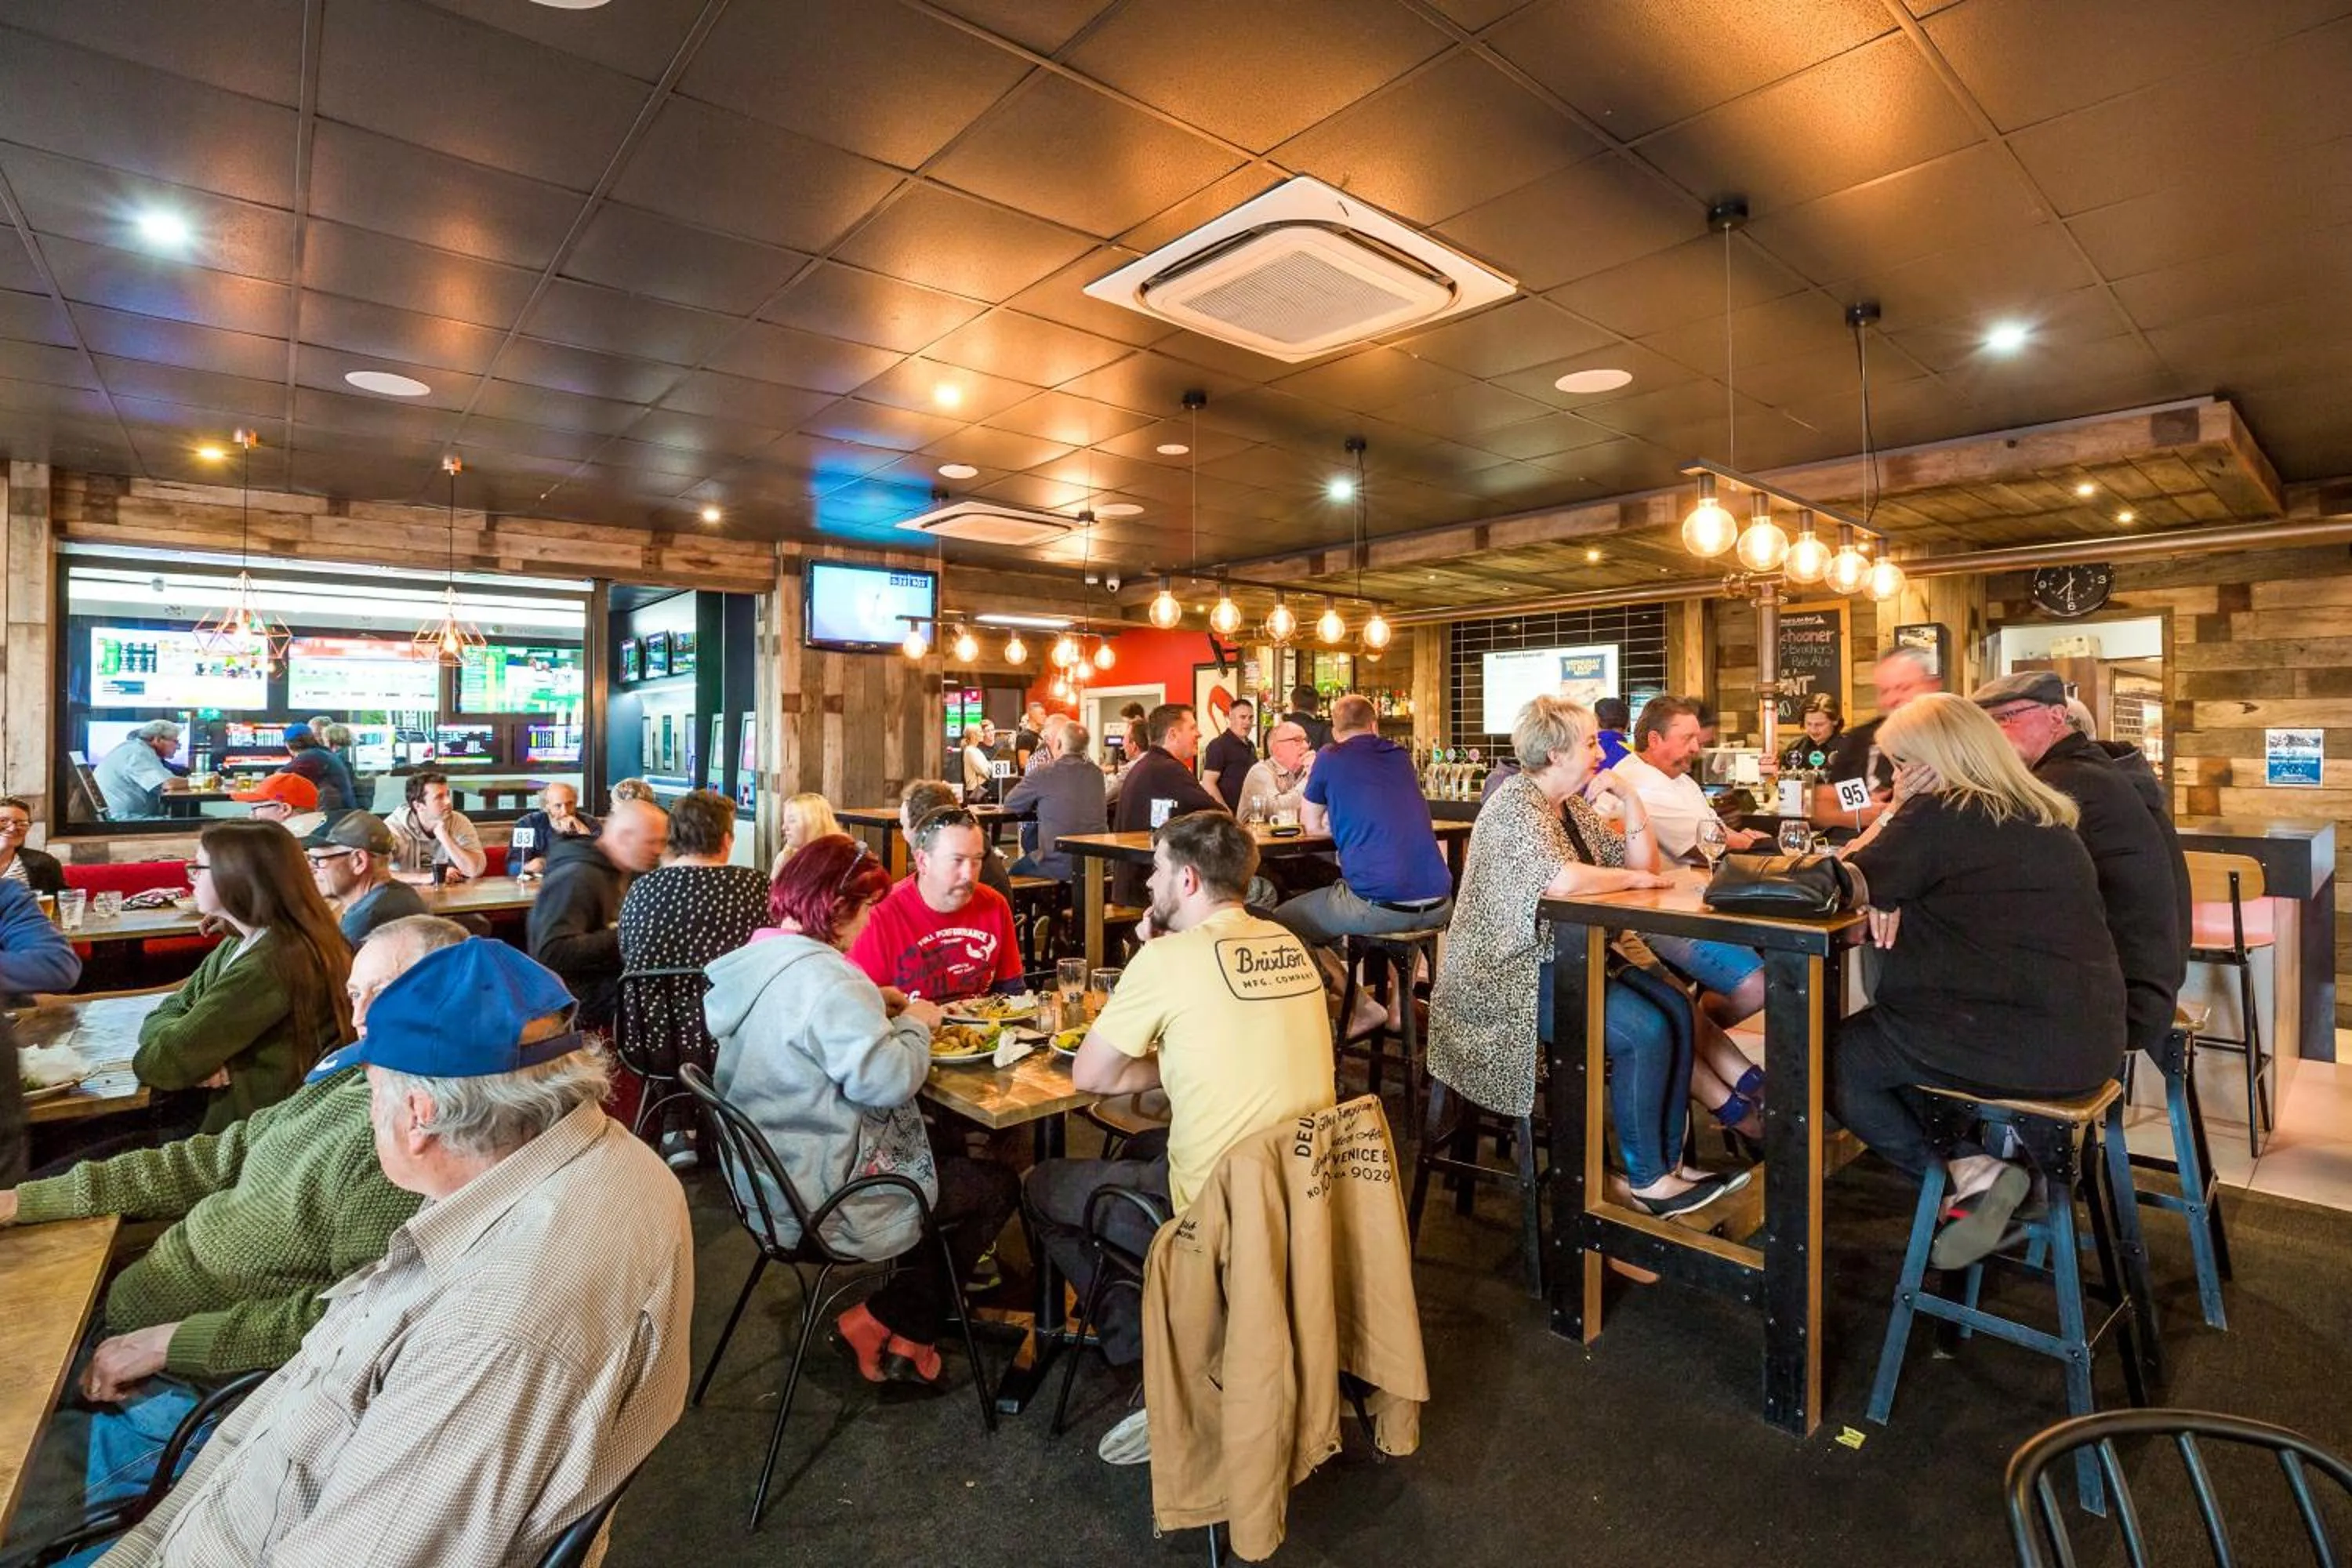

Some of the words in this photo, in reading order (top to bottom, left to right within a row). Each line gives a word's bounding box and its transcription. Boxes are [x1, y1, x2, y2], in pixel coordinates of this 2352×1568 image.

[2097, 575, 2107, 584] 3
[2067, 602, 2076, 611] 6
[1780, 629, 1835, 642] chooner
[995, 763, 1007, 775] 81
[1842, 784, 1864, 805] 95
[517, 831, 531, 844] 83
[1235, 945, 1307, 974] Brixton
[1294, 1112, 1316, 1158] DEU
[1333, 1147, 1379, 1165] VENICE
